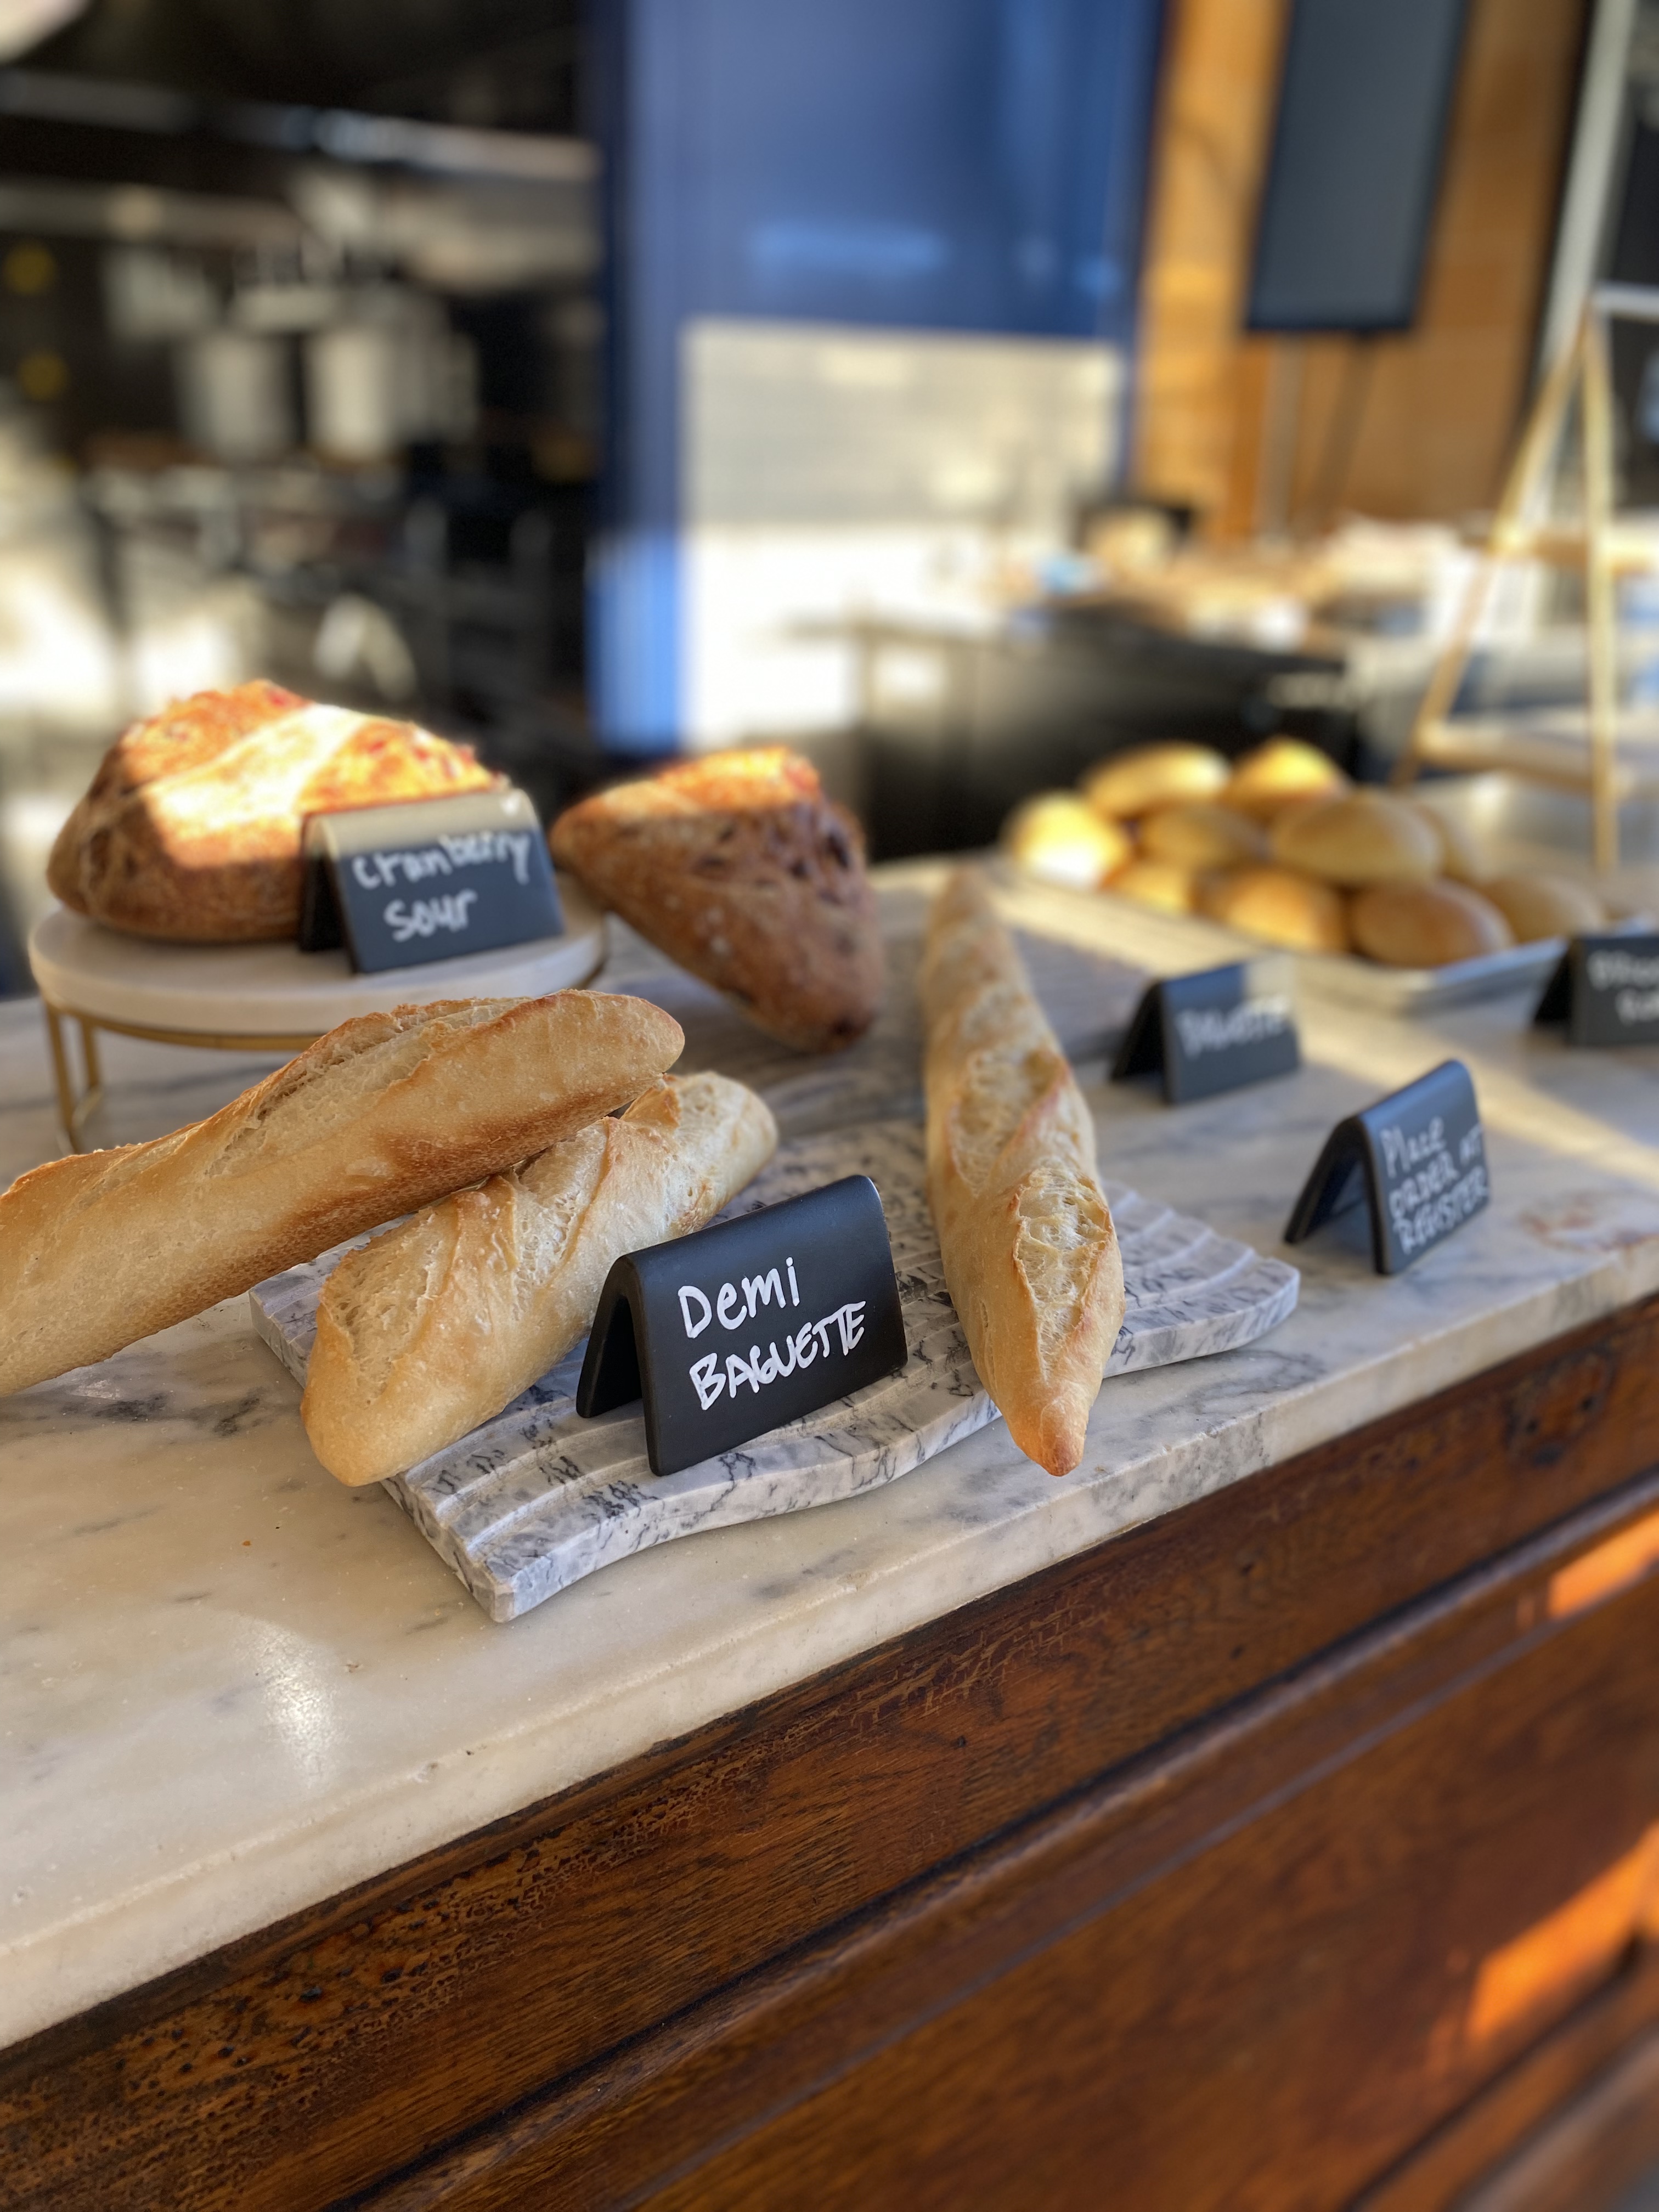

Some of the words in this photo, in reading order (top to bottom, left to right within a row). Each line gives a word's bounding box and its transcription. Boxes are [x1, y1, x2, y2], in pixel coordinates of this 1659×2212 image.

[383, 889, 478, 943] Sour
[678, 1256, 800, 1339] Demi
[689, 1300, 867, 1411] BAGUETTE
